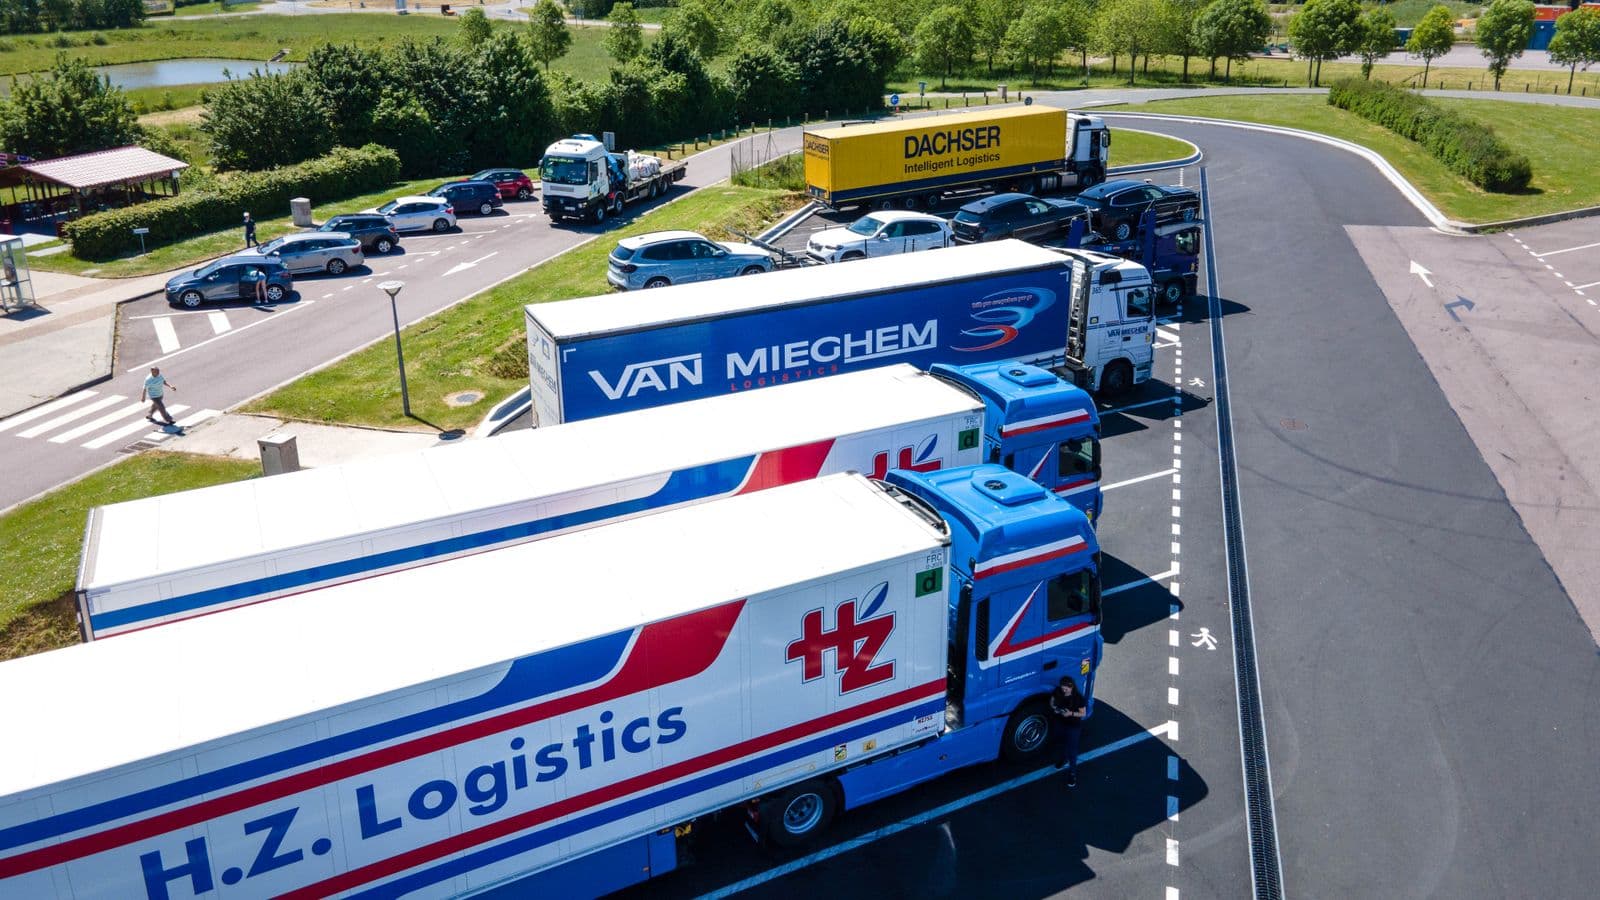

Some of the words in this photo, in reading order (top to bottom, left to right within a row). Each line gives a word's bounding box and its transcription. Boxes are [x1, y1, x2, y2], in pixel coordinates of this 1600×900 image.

[903, 125, 1001, 159] DACHSER
[904, 158, 954, 174] Intelligent
[957, 152, 1000, 167] Logistics
[588, 353, 703, 401] VAN
[726, 319, 938, 380] MIEGHEM
[730, 363, 839, 392] LOGISTICS
[926, 552, 942, 564] FRC
[922, 570, 937, 593] d
[785, 598, 897, 696] HZ
[139, 807, 332, 900] H.Z.
[355, 706, 688, 840] Logistics
